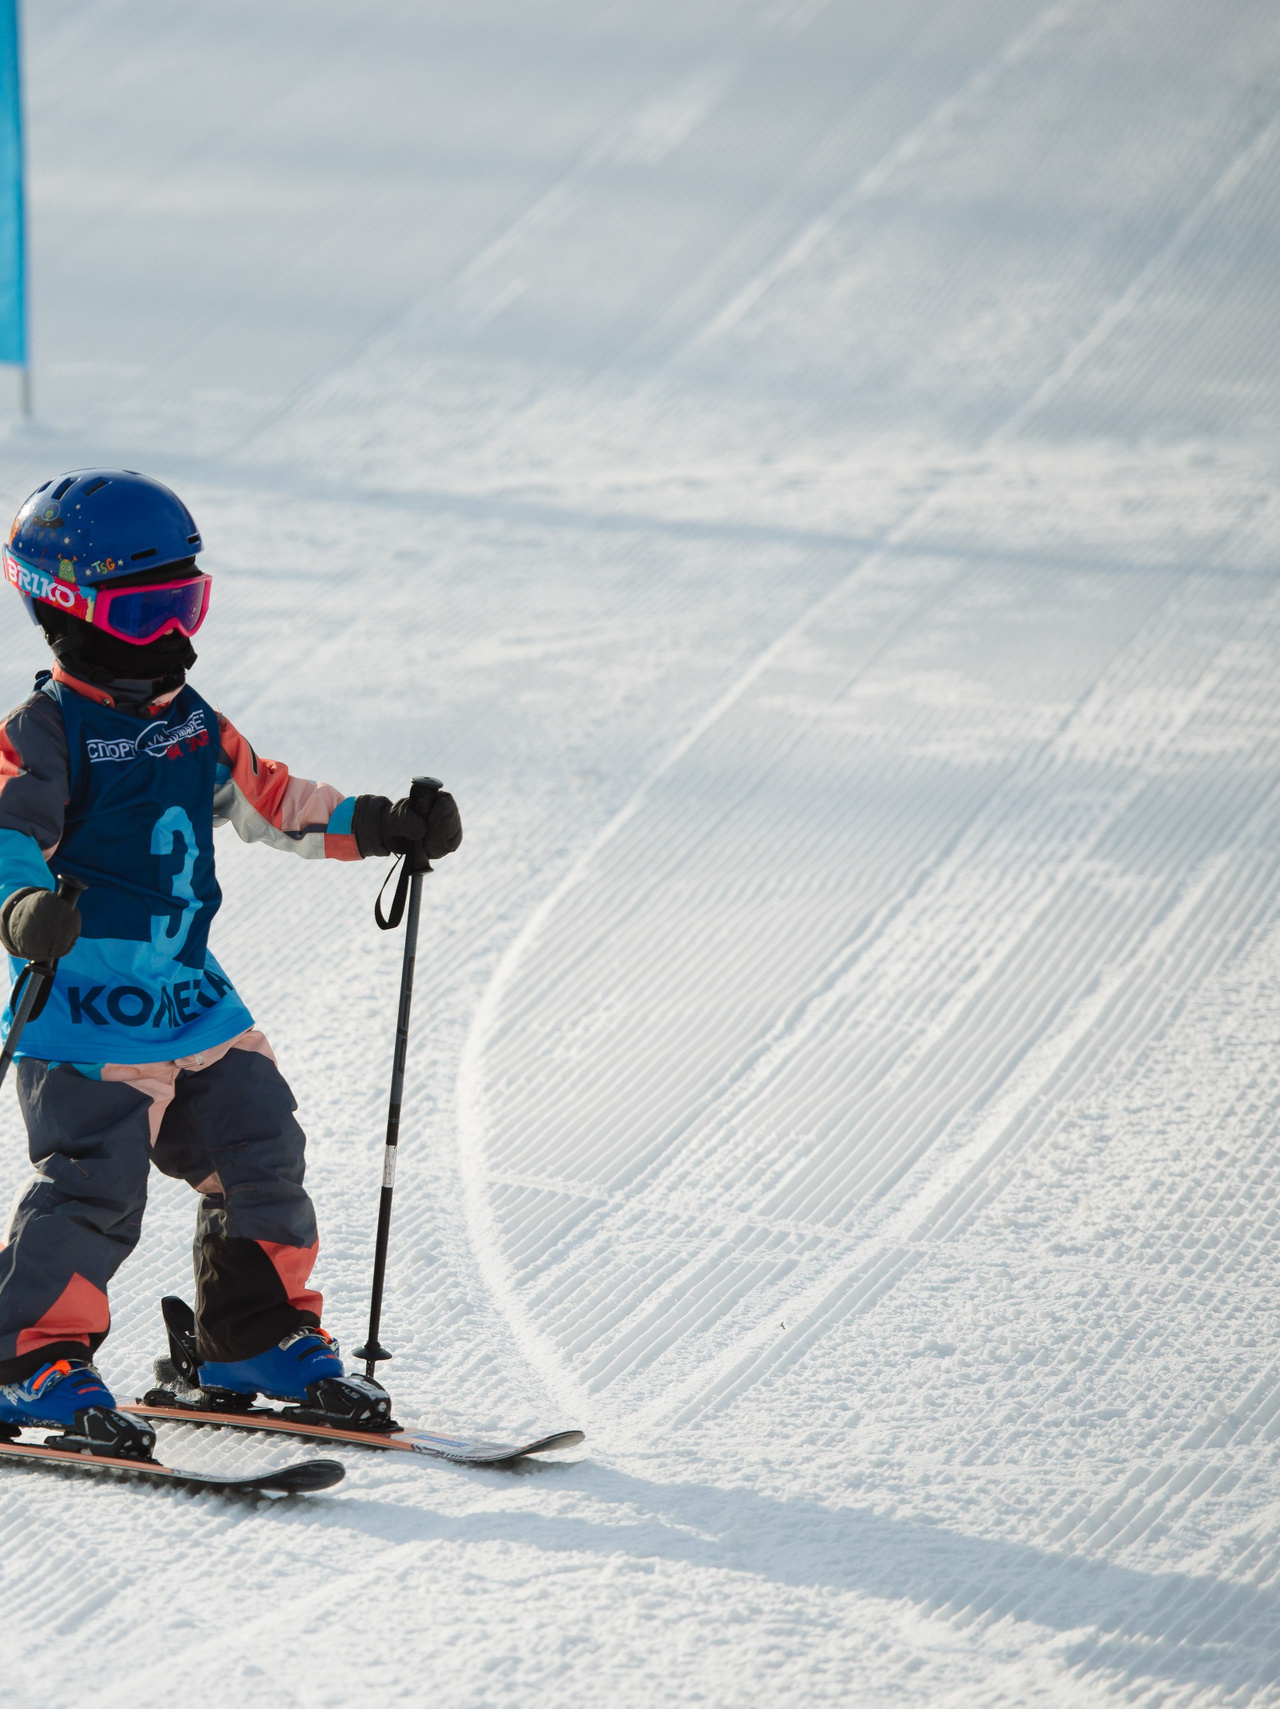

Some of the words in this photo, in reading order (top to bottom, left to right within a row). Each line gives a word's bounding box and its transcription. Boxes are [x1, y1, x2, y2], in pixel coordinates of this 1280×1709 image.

[7, 560, 76, 607] BRIKO
[91, 557, 116, 575] TSG
[150, 806, 203, 962] 3
